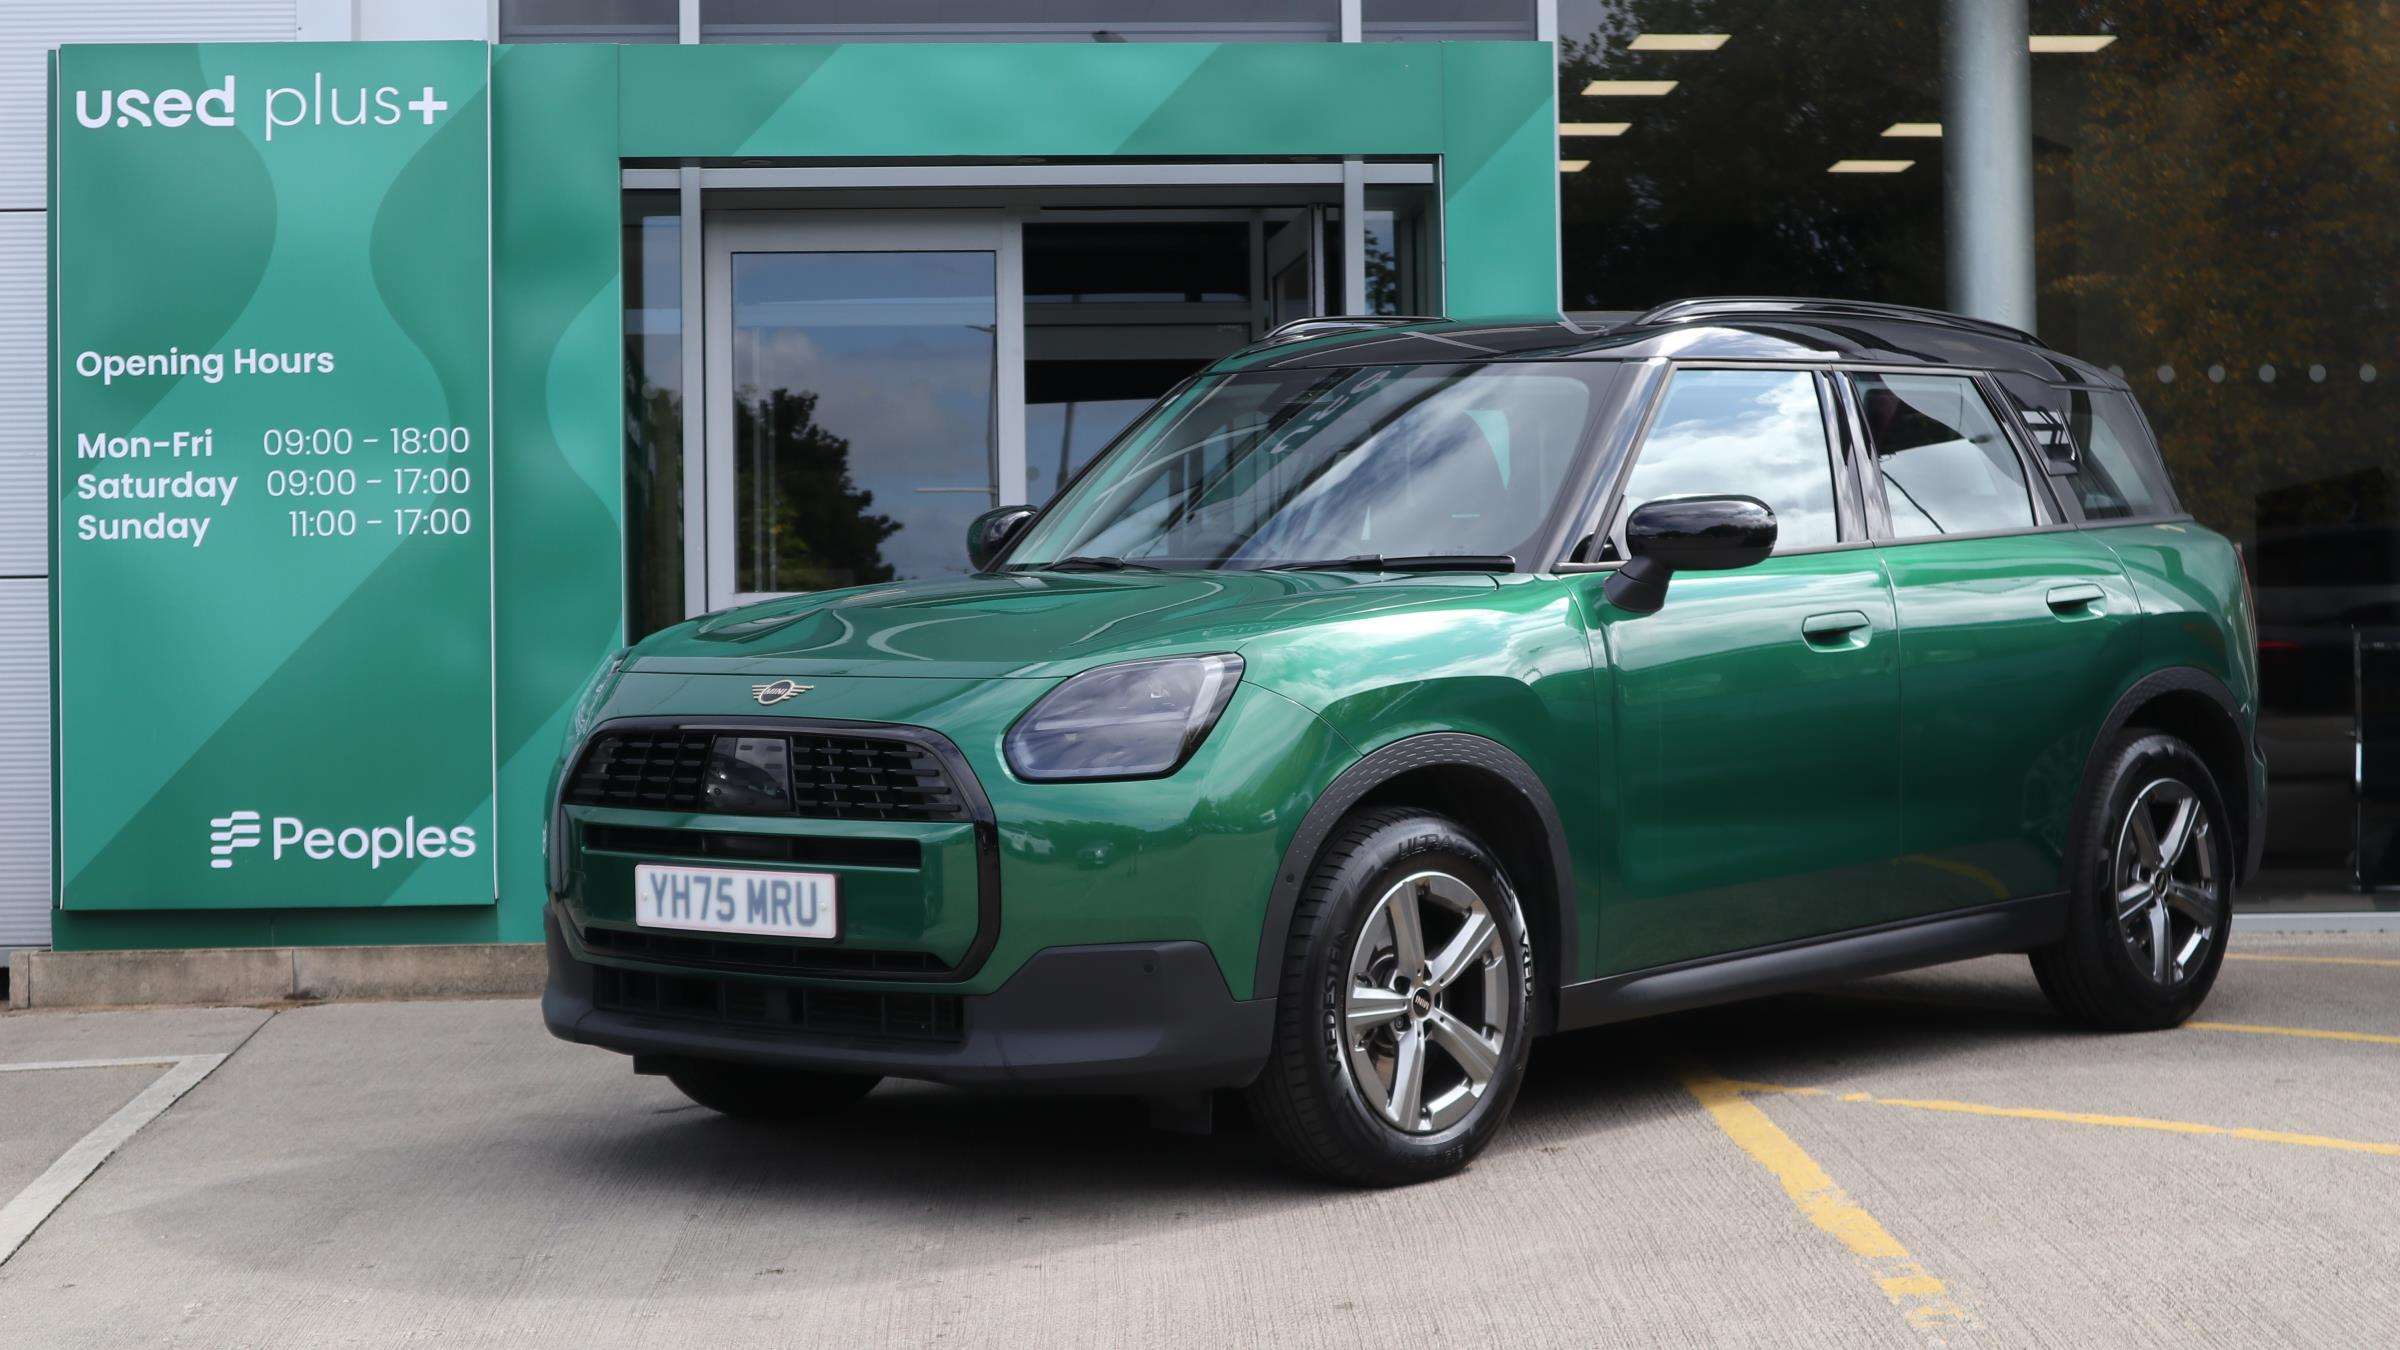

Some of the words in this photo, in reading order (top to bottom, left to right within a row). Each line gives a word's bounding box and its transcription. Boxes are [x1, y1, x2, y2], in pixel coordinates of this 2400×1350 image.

[76, 74, 235, 128] used
[76, 347, 224, 385] Opening
[234, 348, 335, 375] Hours
[77, 428, 213, 459] Mon-Fri
[263, 428, 353, 456] 09:00
[390, 426, 470, 455] 18:00
[77, 470, 239, 507] Saturday
[267, 468, 357, 497] 09:00
[393, 467, 471, 495] 17:00
[78, 511, 211, 548] Sunday
[288, 509, 357, 537] 11:00
[394, 508, 471, 536] 17:00
[273, 815, 477, 869] Peoples
[651, 873, 736, 922] YH75
[747, 879, 818, 928] MRU
